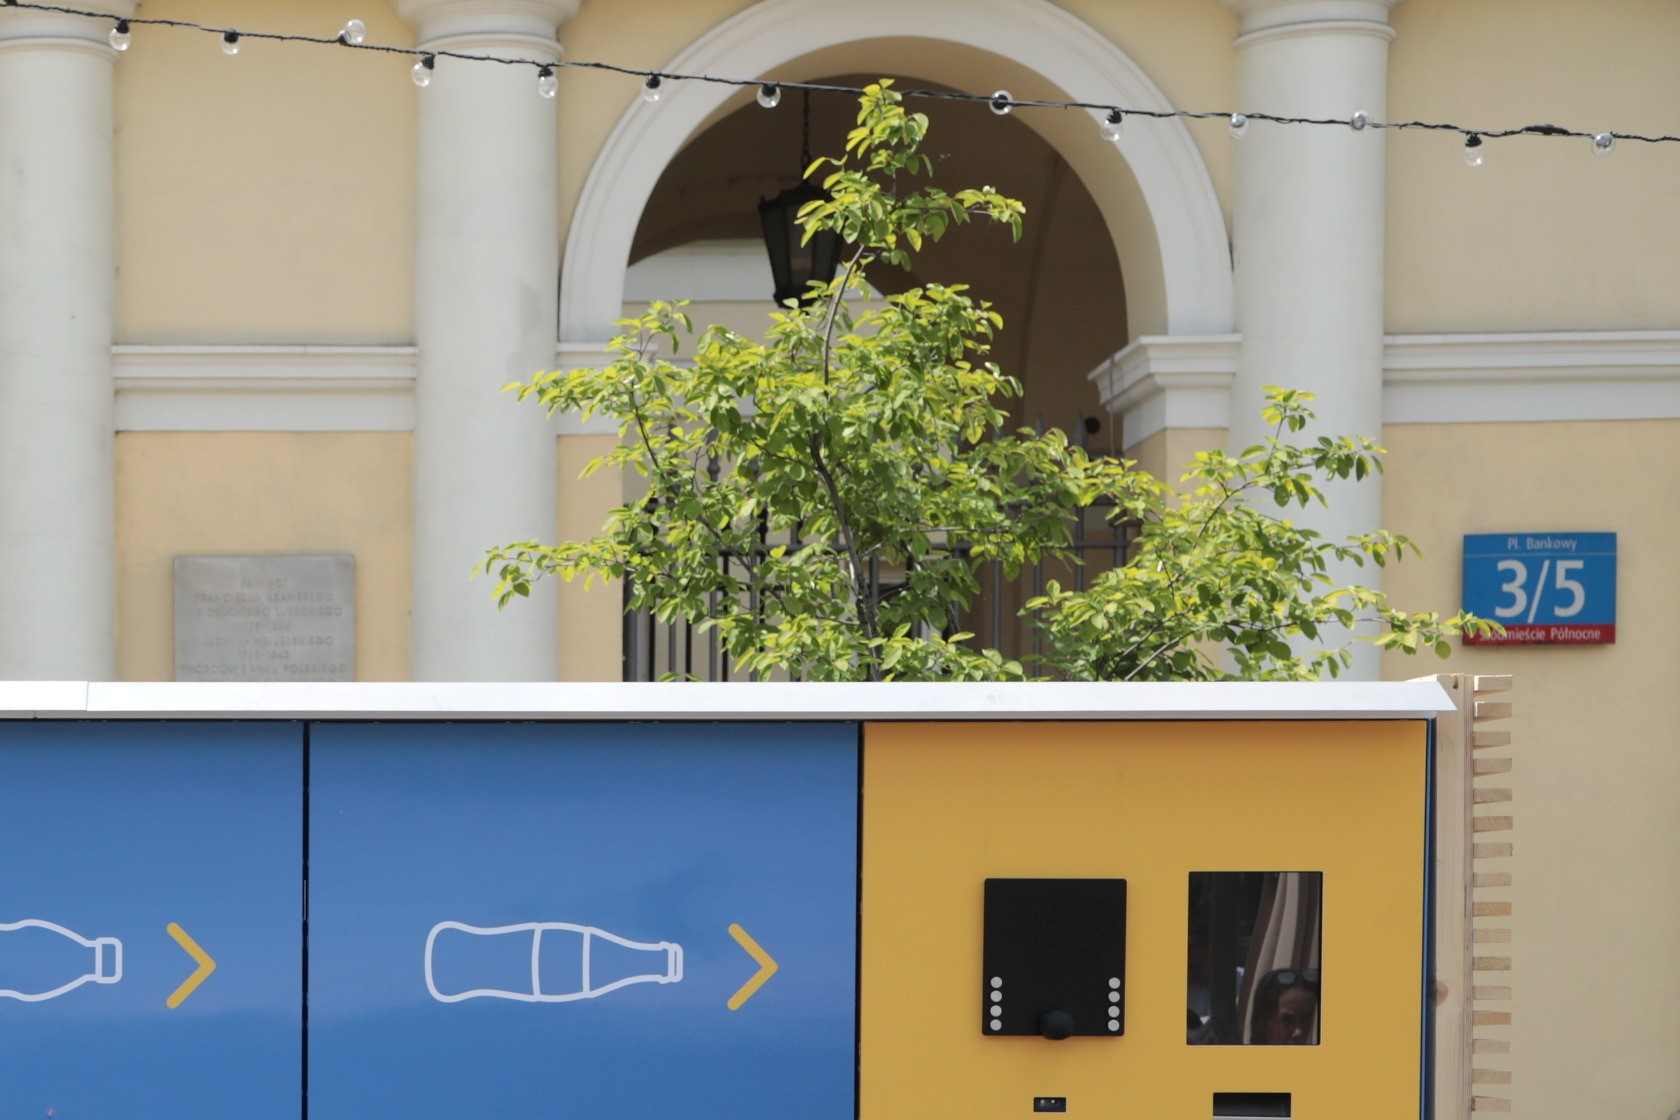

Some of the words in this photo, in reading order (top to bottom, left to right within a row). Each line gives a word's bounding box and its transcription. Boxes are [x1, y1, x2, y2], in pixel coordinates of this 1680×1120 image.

[1507, 537, 1520, 550] Pl.
[1526, 537, 1577, 551] Bankowy
[1494, 559, 1586, 624] 3/5
[1479, 626, 1546, 641] ómieście
[1550, 626, 1601, 641] Północne
